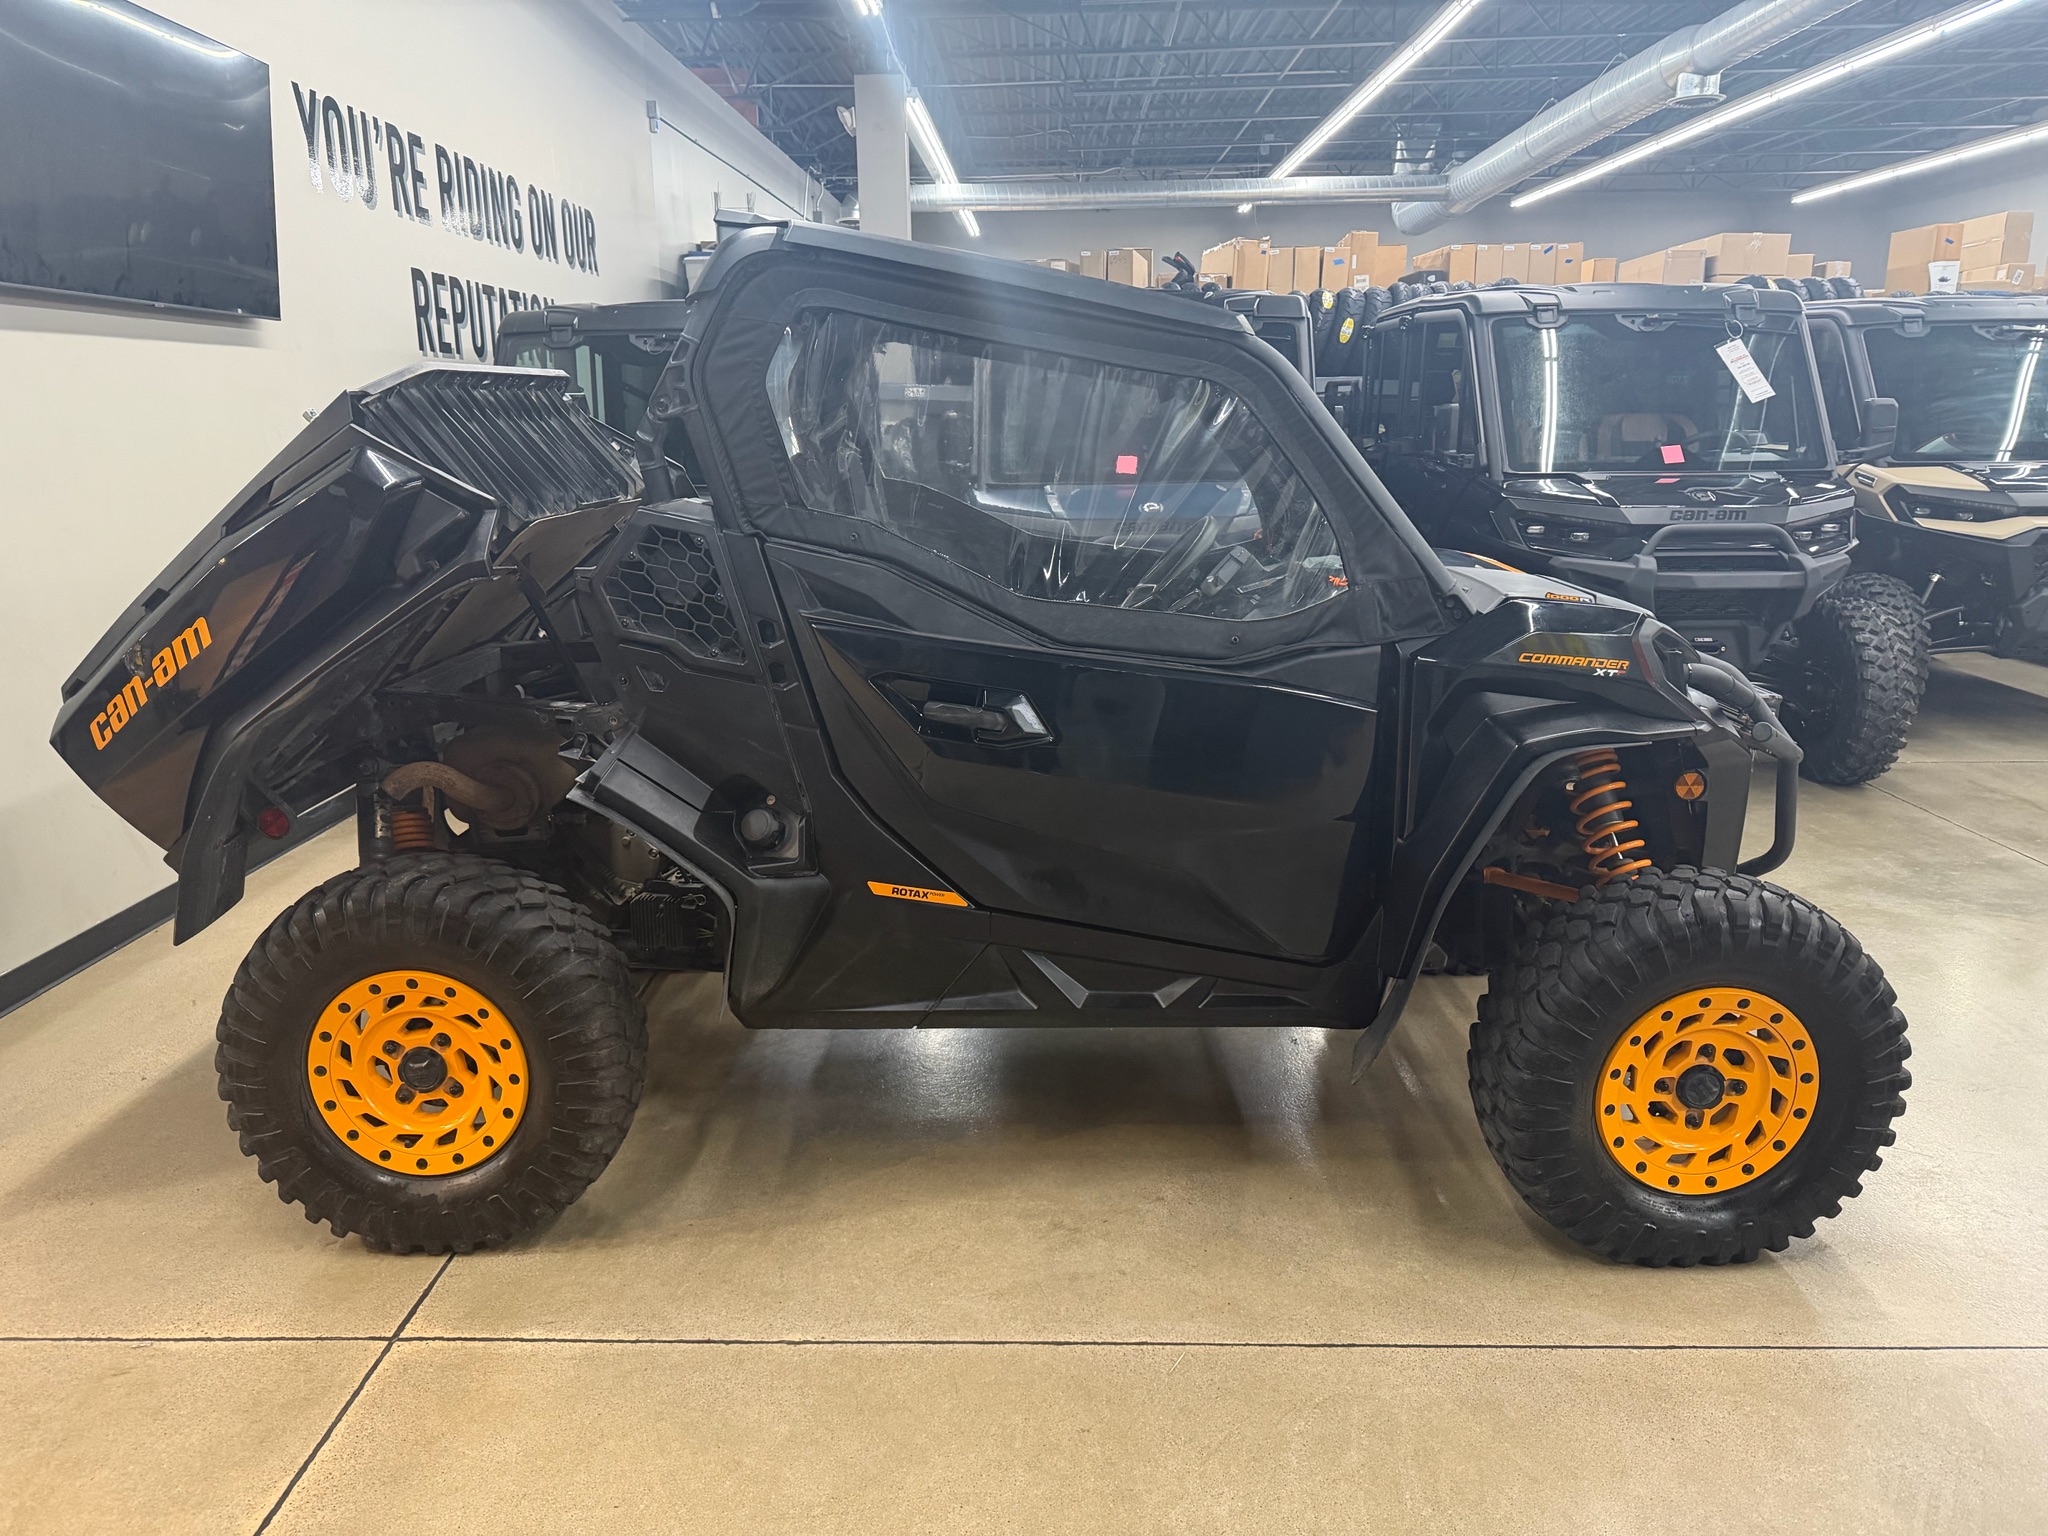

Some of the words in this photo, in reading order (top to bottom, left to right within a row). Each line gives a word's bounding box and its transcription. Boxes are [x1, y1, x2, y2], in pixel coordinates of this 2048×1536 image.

[291, 81, 433, 227] YOU'RE
[435, 143, 524, 254] RIDING
[527, 184, 559, 264] ON
[561, 199, 599, 276] OUR
[410, 267, 555, 363] REPUT
[1669, 509, 1747, 521] can-am
[89, 616, 213, 751] can-am
[1518, 652, 1630, 670] COMMANDER
[891, 886, 930, 900] ROTAX
